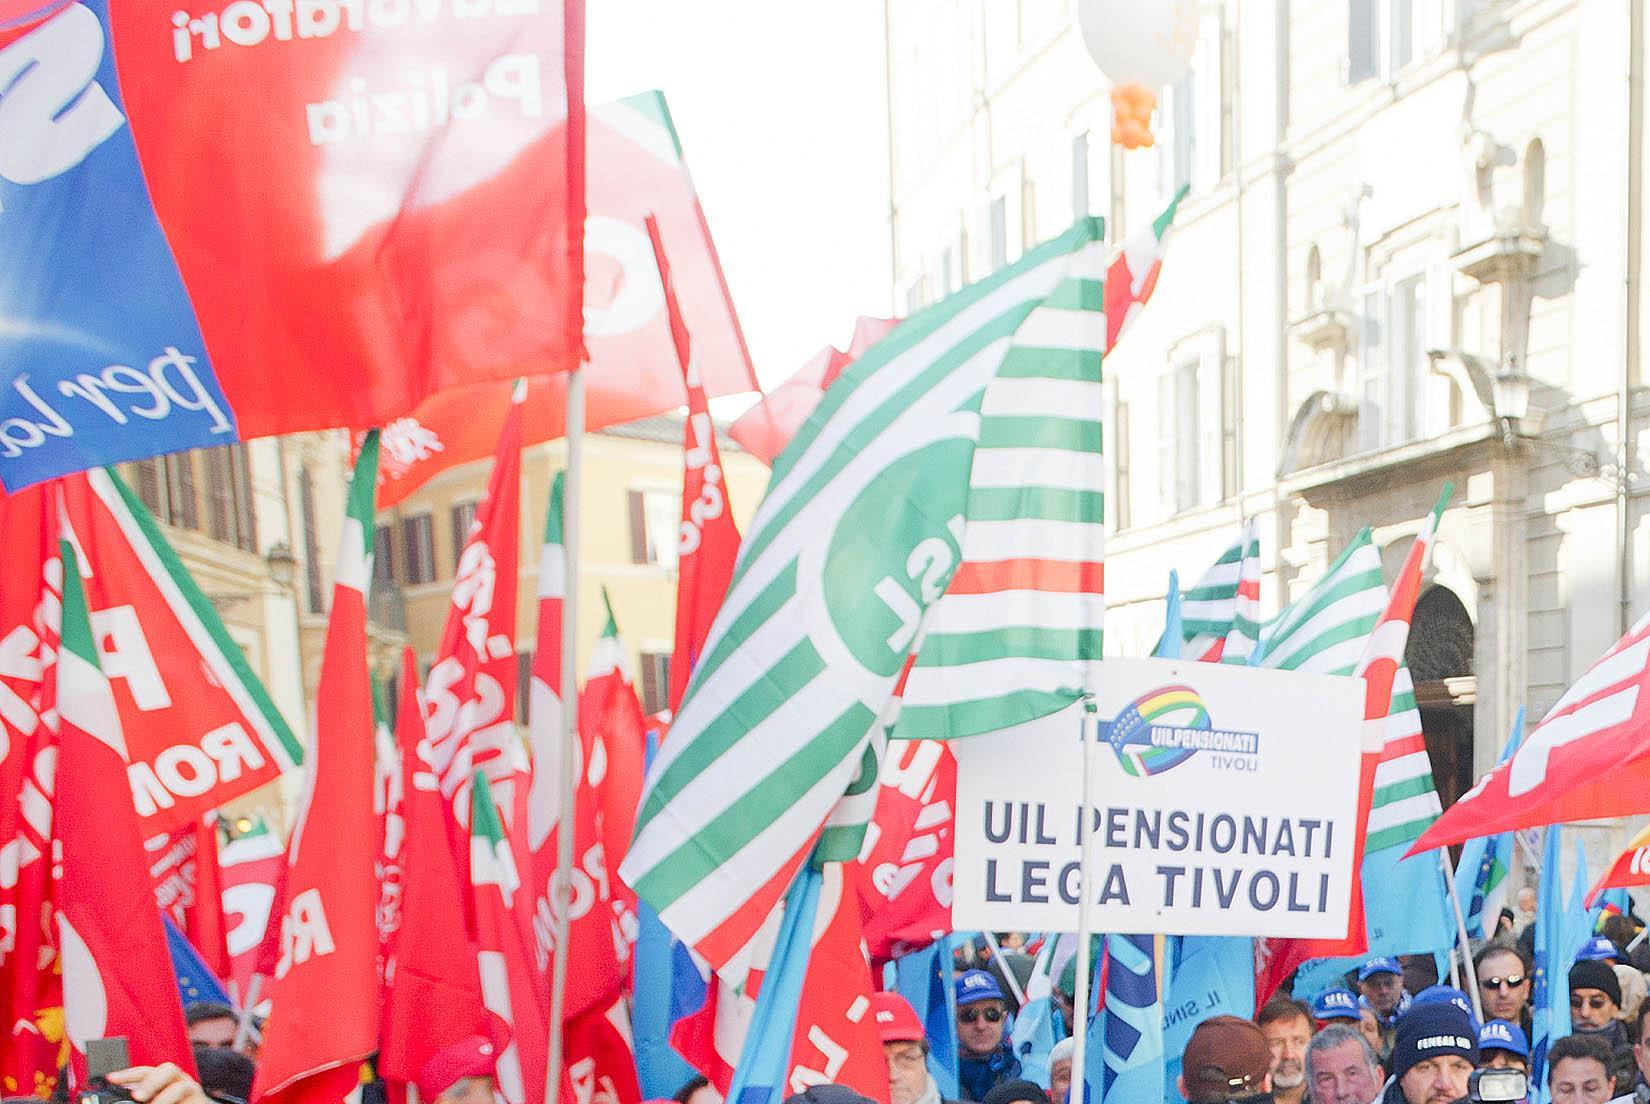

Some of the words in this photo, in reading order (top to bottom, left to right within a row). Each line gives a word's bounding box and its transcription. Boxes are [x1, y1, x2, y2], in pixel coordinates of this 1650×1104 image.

[1211, 756, 1258, 772] TIVOLI
[983, 800, 1058, 846] UIL
[1075, 807, 1334, 860] PENSIONATI
[984, 859, 1131, 907] LEGA
[1157, 865, 1330, 914] TIVOLI
